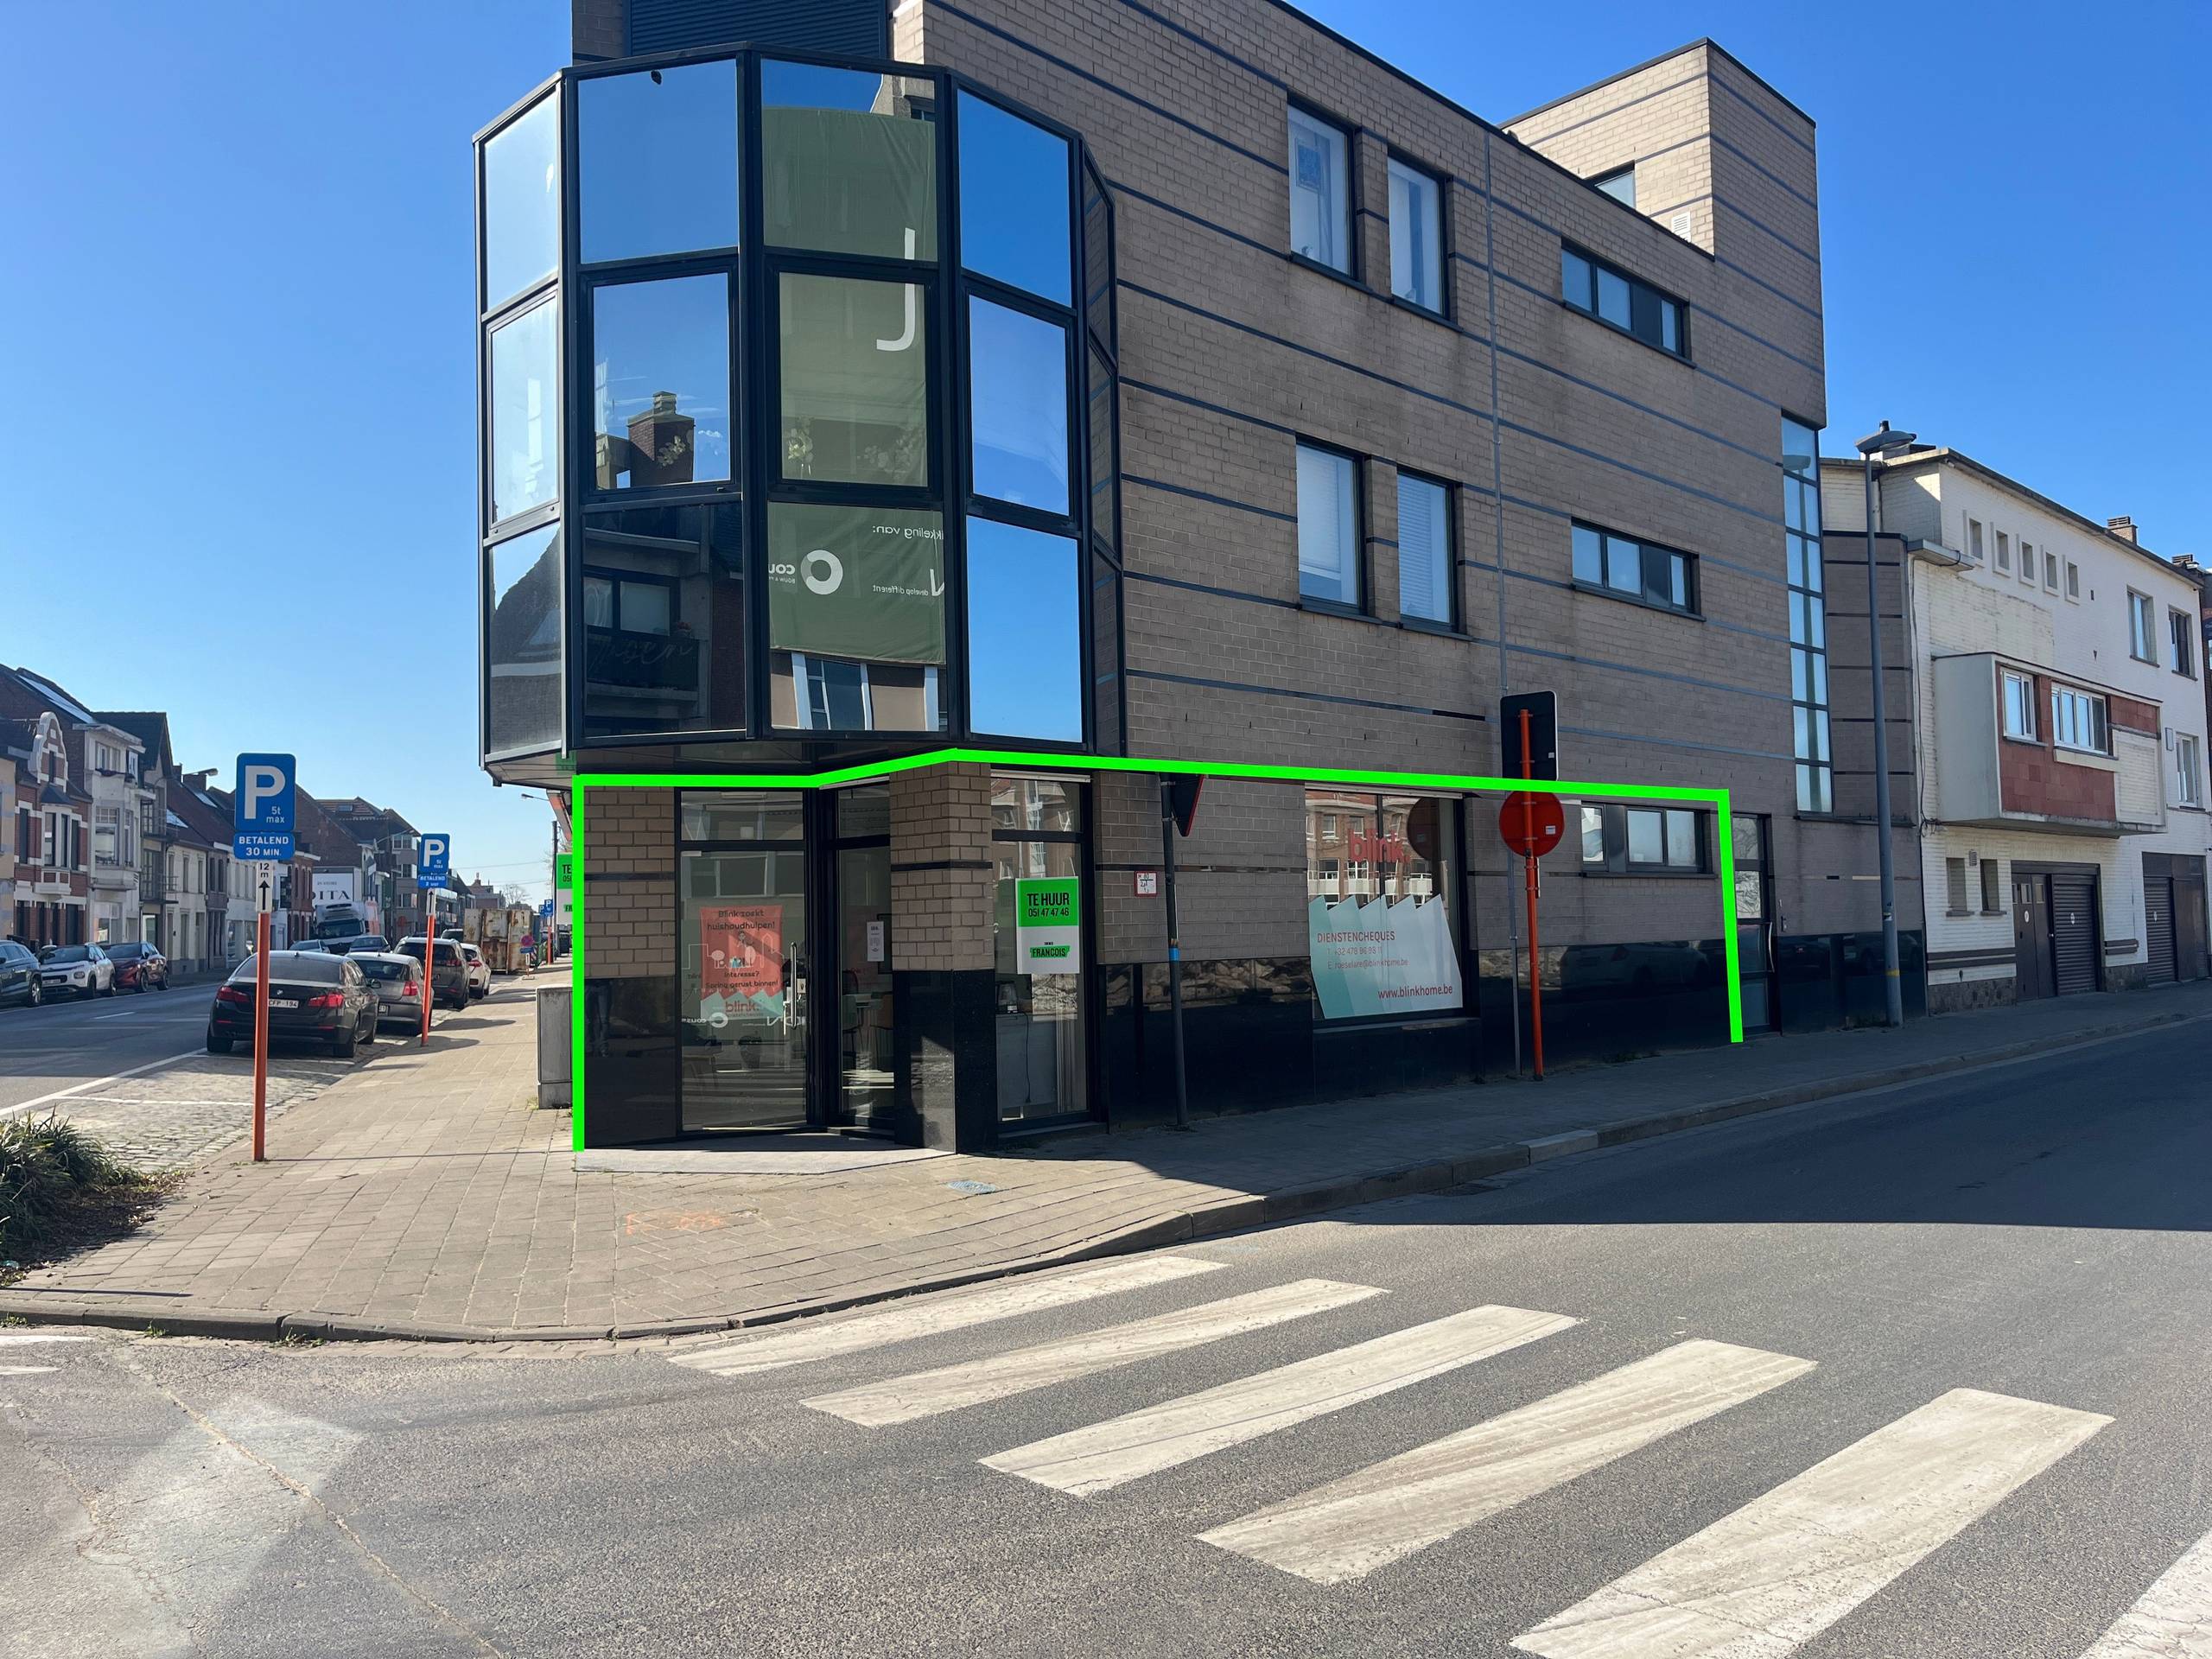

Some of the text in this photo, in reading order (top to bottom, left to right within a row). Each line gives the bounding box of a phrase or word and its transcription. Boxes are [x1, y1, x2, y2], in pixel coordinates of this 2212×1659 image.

[245, 765, 286, 820] P
[271, 805, 282, 815] 5t
[245, 848, 260, 856] 30
[423, 839, 445, 868] P
[1027, 892, 1070, 906] TE HUUR
[1028, 908, 1039, 917] 051
[1040, 907, 1049, 917] 47
[1050, 907, 1058, 916] 47
[1317, 931, 1395, 944] DIENSTENCHEQUES
[1377, 983, 1453, 1000] www.blinkhome.be
